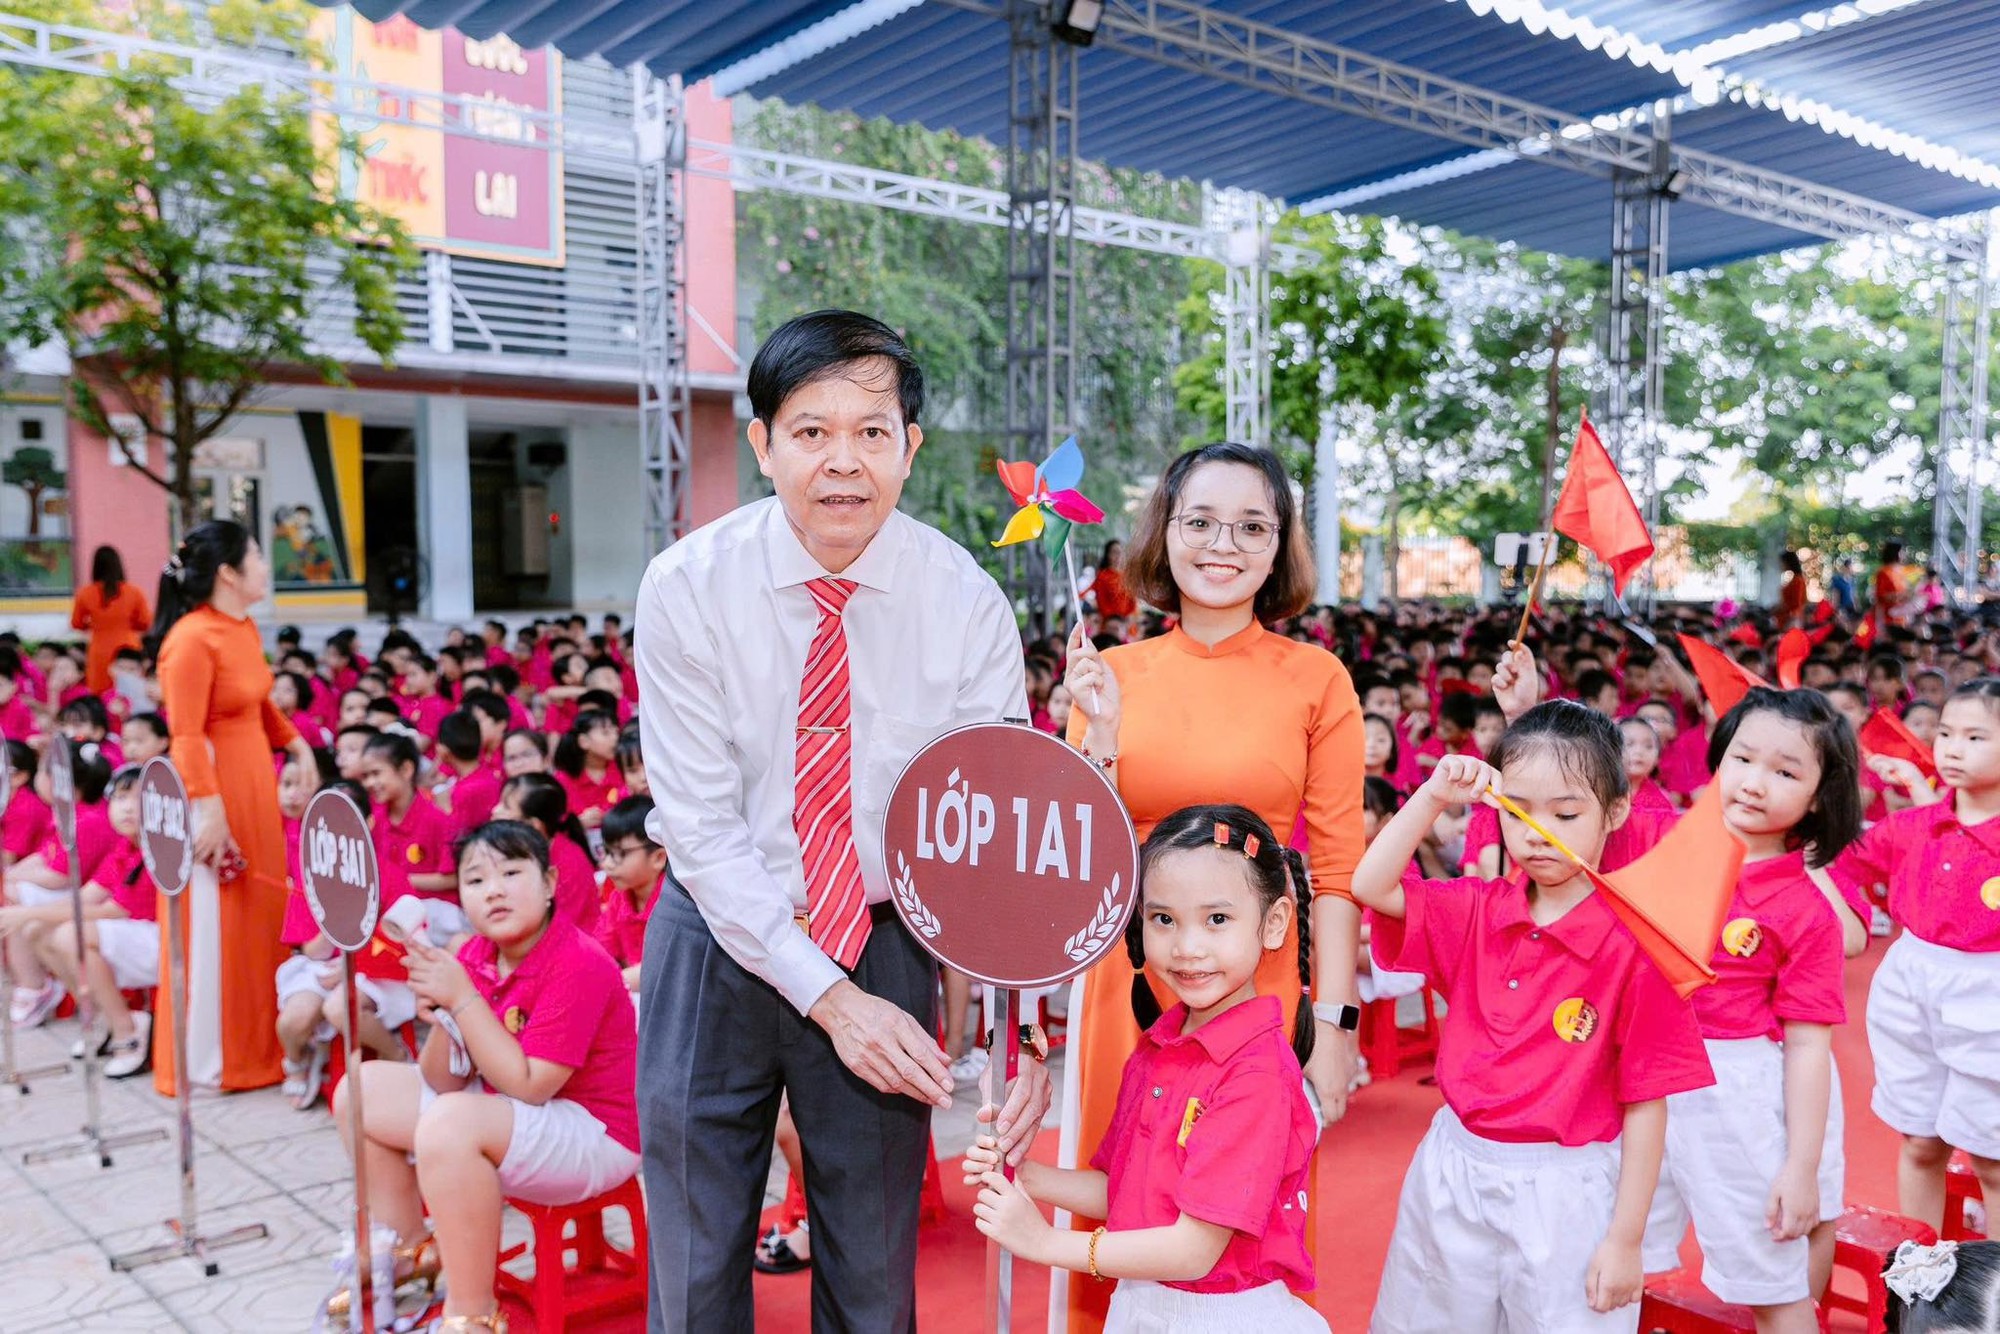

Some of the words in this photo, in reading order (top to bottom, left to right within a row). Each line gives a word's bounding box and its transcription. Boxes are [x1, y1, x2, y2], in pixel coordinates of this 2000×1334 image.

[309, 816, 338, 878] LỚP
[338, 834, 366, 888] 3A1
[917, 766, 995, 866] LỚP
[1012, 797, 1092, 881] 1A1
